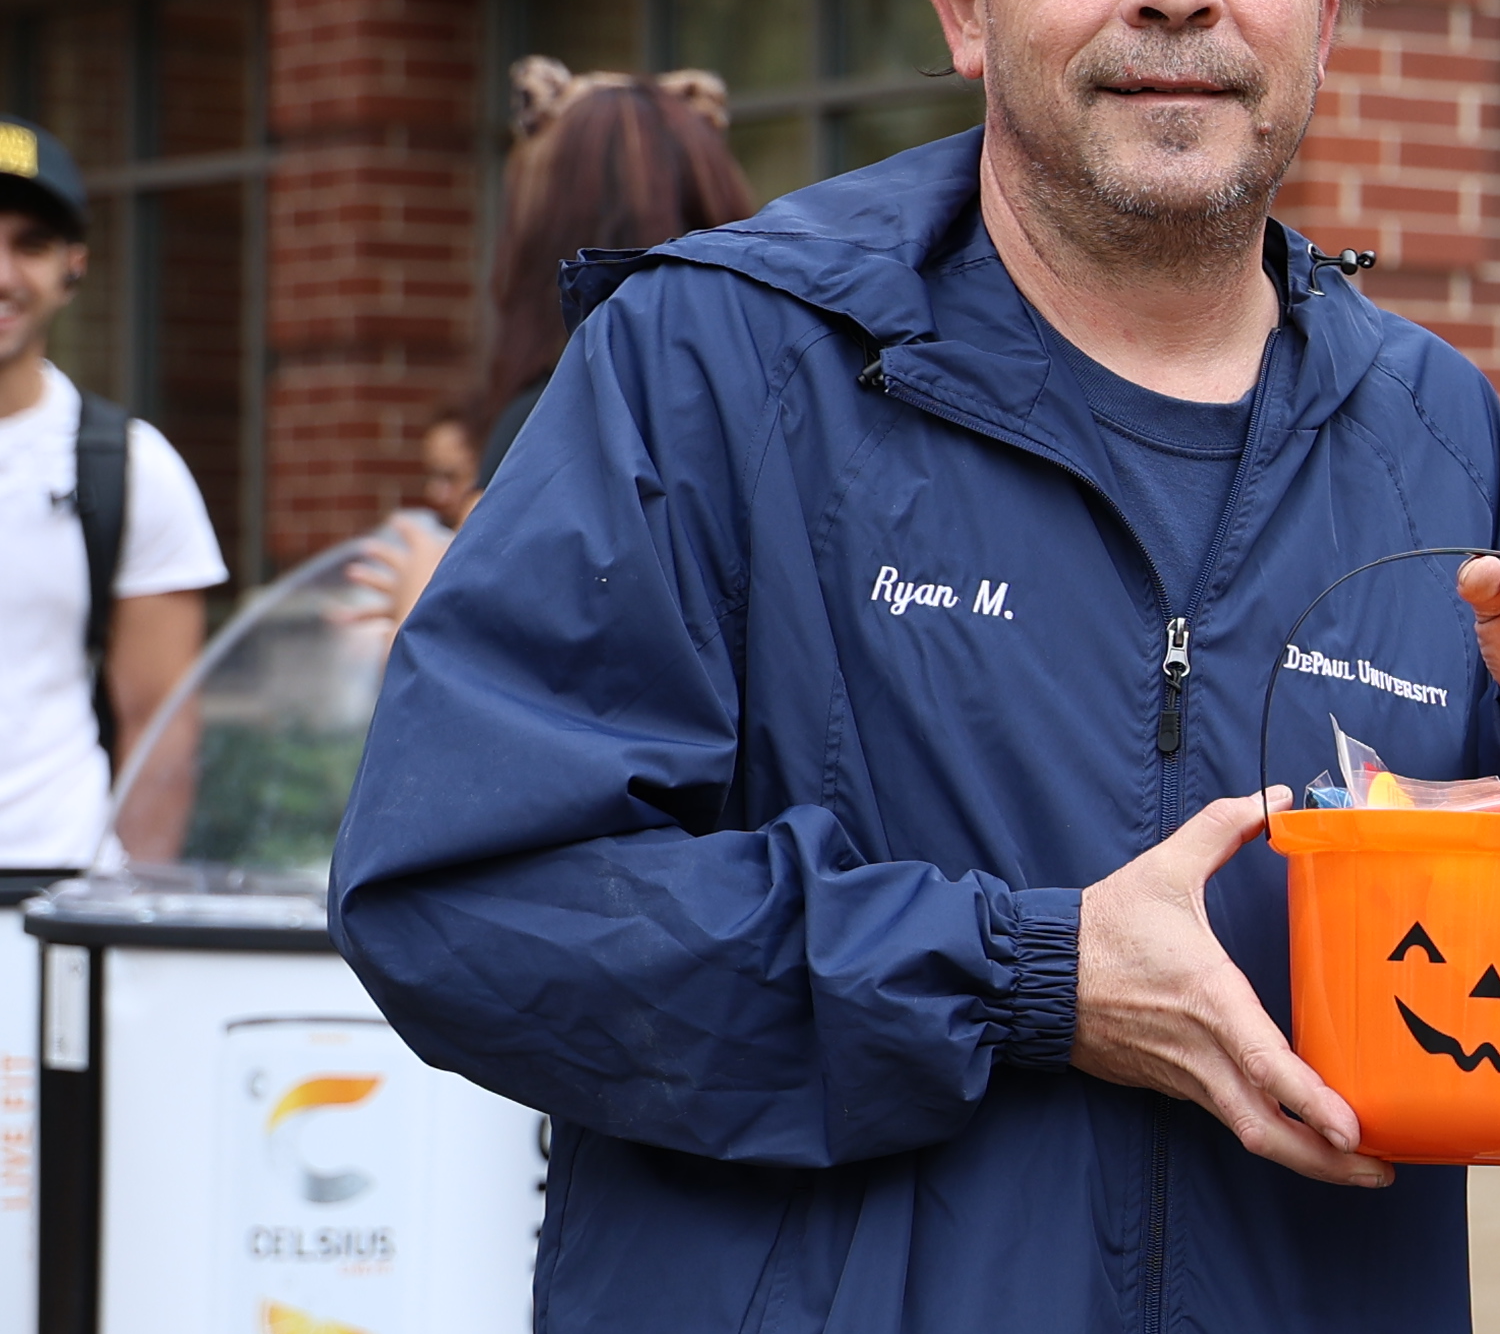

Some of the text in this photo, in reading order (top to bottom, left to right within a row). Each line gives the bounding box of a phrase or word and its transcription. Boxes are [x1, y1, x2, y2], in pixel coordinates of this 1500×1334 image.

[870, 565, 1015, 620] Ryan M.
[1356, 658, 1449, 708] UNIVERSITY
[247, 1223, 398, 1263] CELSIUS
